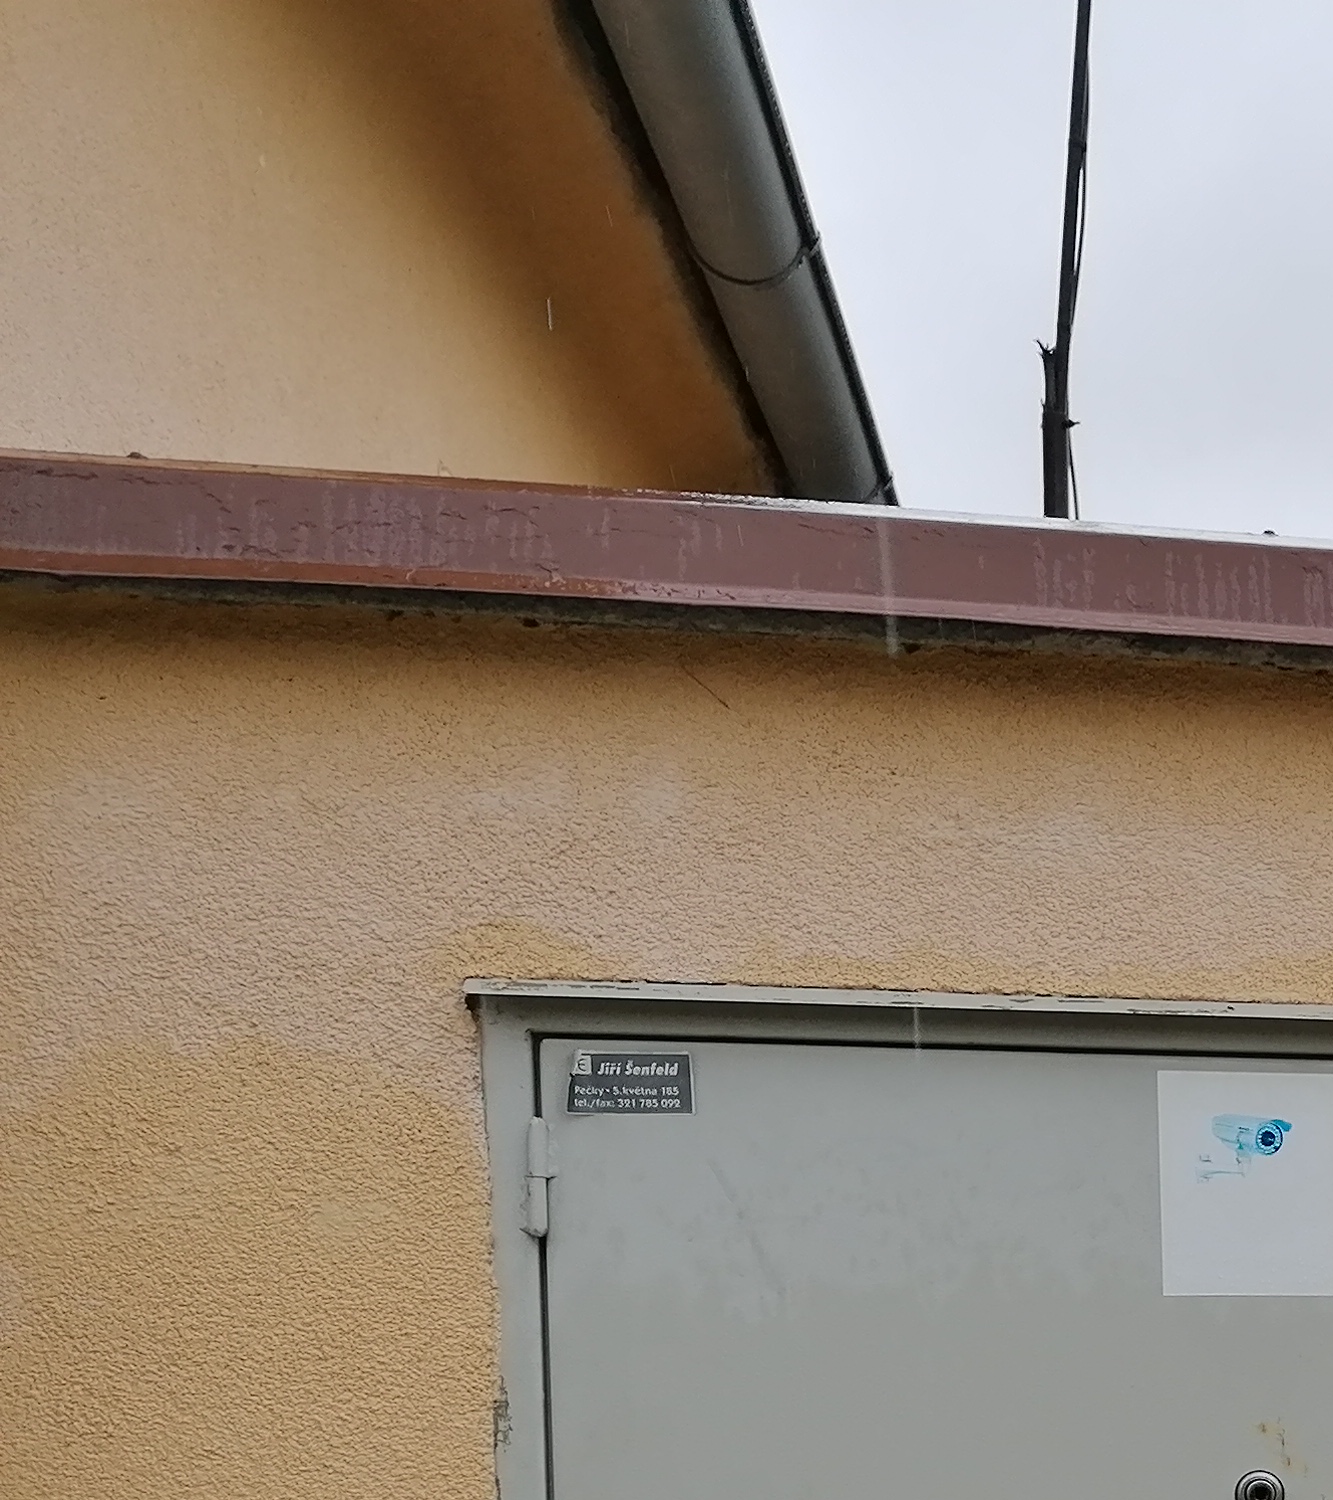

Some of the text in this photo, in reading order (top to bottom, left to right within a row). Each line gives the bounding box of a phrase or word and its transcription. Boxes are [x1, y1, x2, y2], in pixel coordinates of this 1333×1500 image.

[597, 1060, 679, 1076] Jiří Šenfeld
[661, 1086, 680, 1096] 185
[617, 1098, 637, 1109] 321
[660, 1099, 681, 1109] 092
